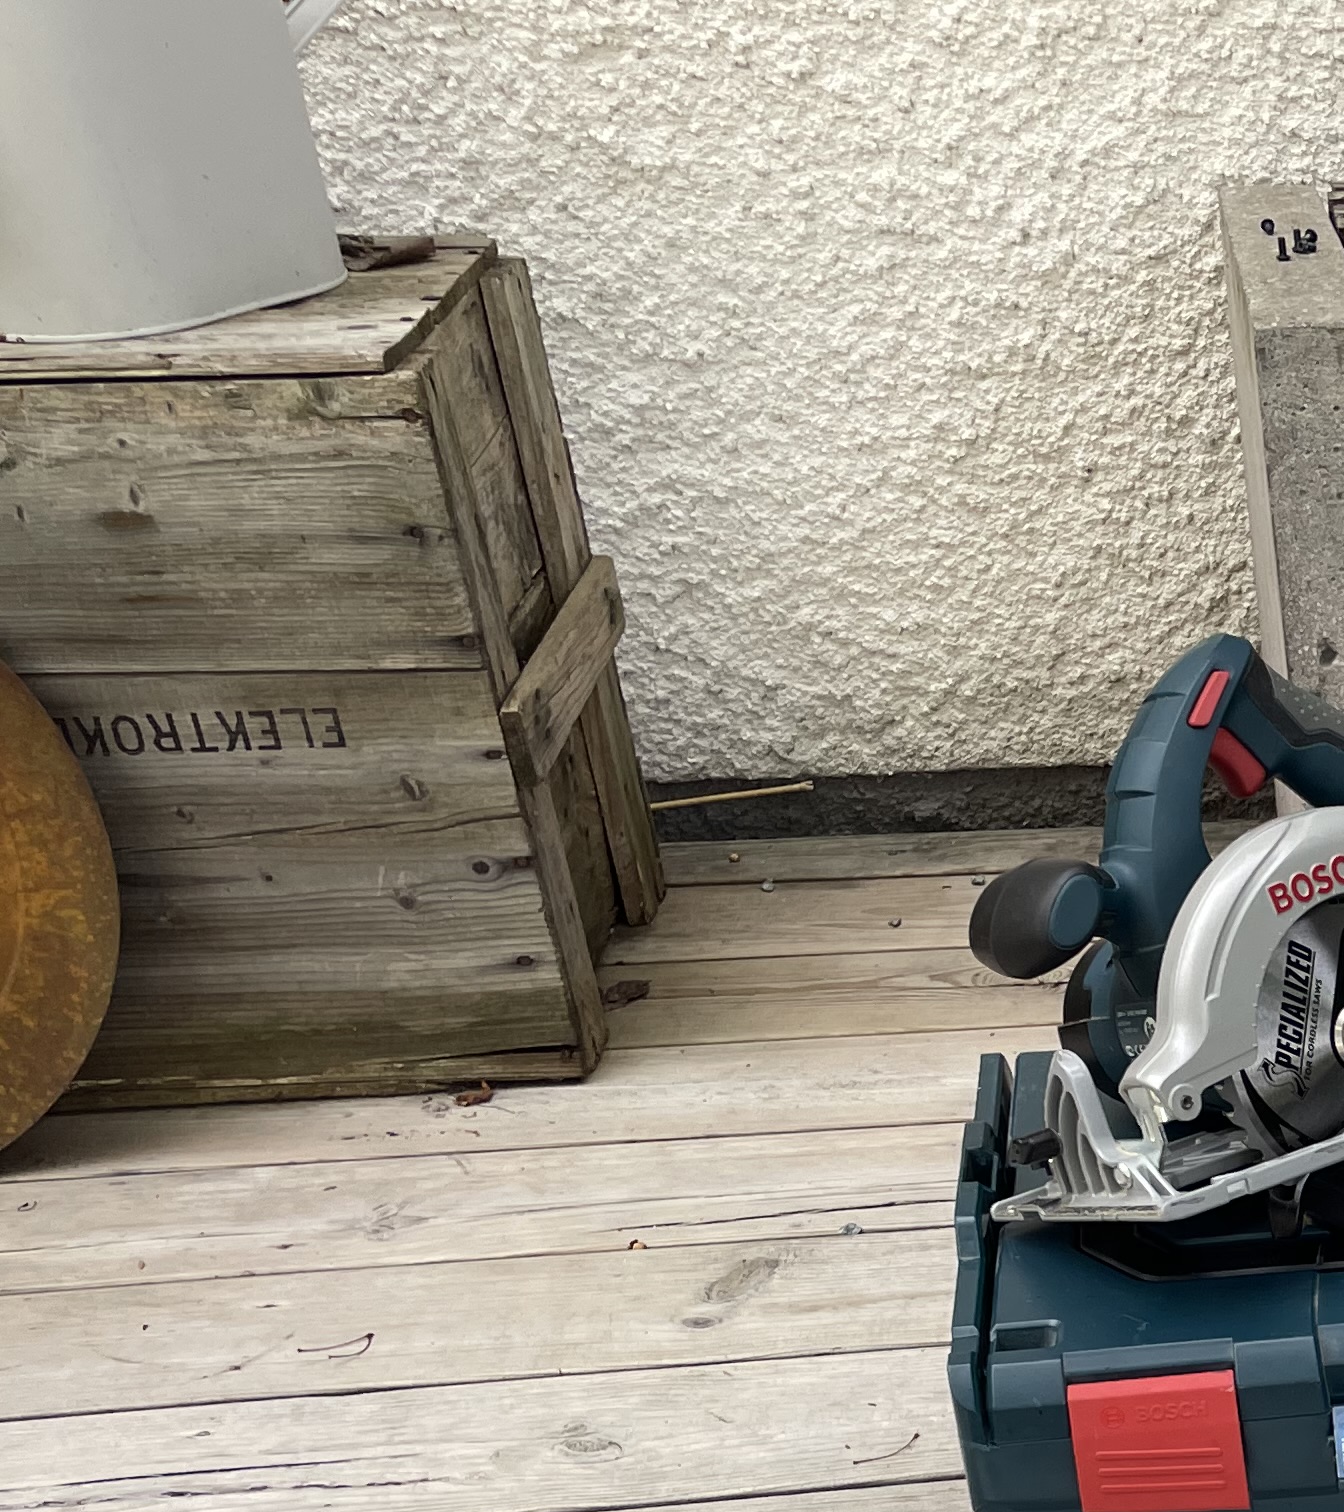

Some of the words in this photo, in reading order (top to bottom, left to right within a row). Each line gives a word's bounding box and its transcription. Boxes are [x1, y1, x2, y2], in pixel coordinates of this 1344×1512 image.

[1313, 978, 1323, 1005] SAWS
[1257, 939, 1314, 1100] SPECIALIZED
[1308, 1006, 1320, 1059] CORDLESS
[1135, 1400, 1207, 1423] BOSCH
